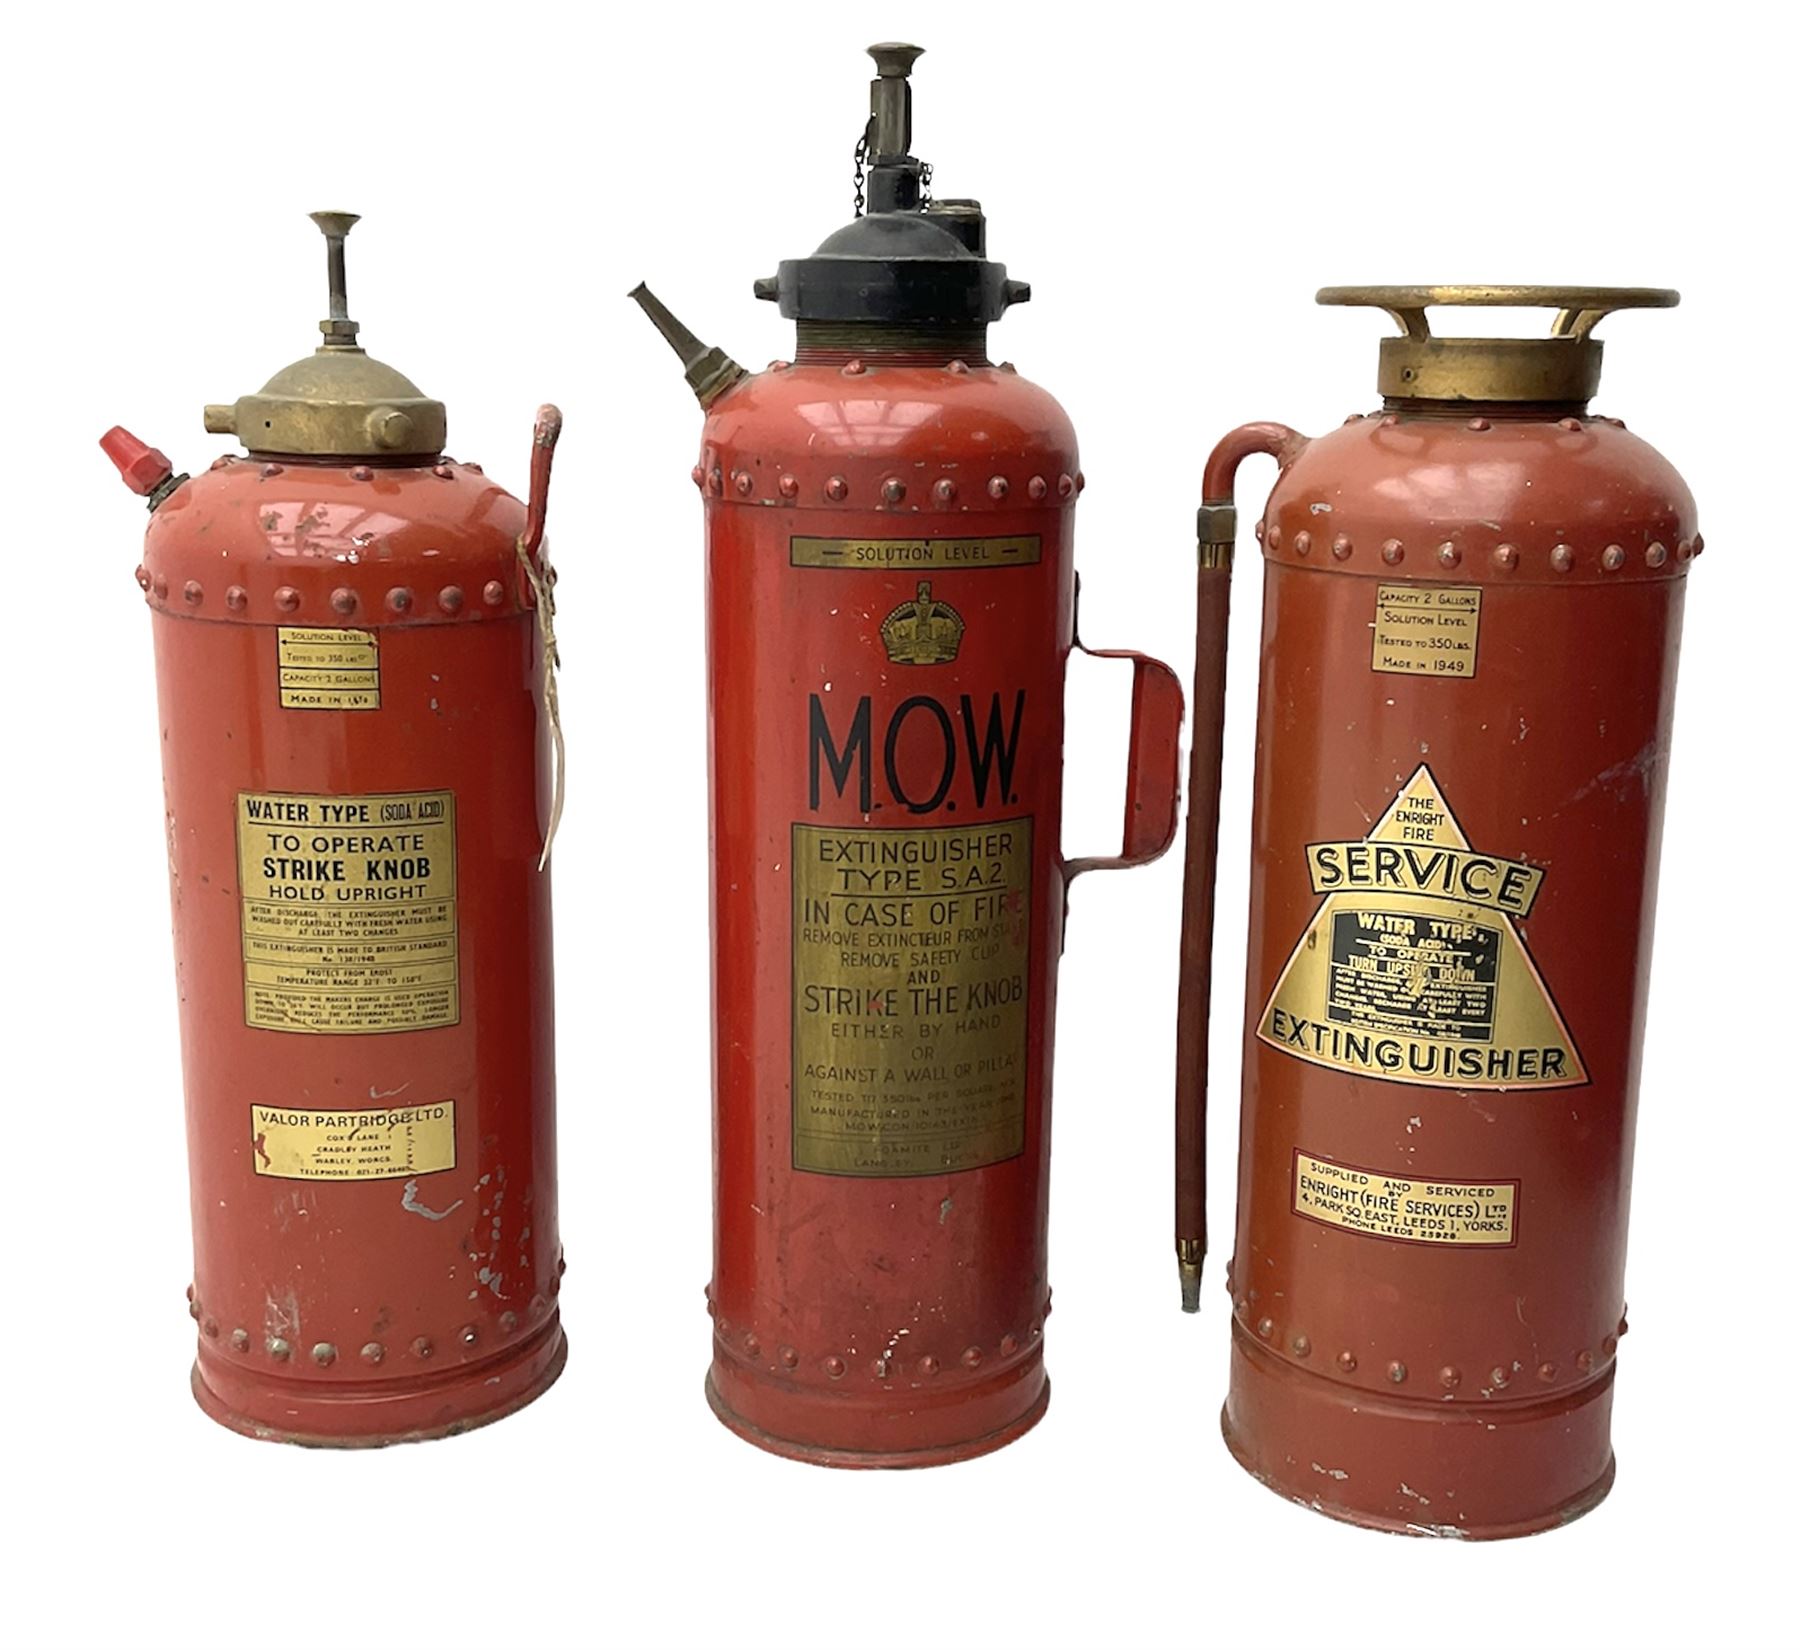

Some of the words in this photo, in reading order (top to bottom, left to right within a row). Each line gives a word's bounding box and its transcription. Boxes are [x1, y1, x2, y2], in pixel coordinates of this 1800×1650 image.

[856, 547, 933, 561] SOLUTION
[945, 546, 990, 560] LEVEL
[1379, 590, 1420, 603] CAPACITY
[1424, 593, 1432, 604] 2
[1438, 594, 1477, 606] GALLONS
[1384, 610, 1434, 625] SOLUTION
[1437, 614, 1468, 627] LEVEL
[291, 632, 334, 641] SOLUTION
[338, 634, 362, 642] LEVEL
[1415, 640, 1427, 648] TO
[1383, 656, 1411, 669] MADE
[1434, 660, 1465, 672] 1949
[325, 675, 332, 683] 2
[291, 695, 321, 704] MADE
[329, 696, 341, 704] IN
[809, 688, 1026, 815] M.O.W.
[247, 799, 309, 822] WATER
[319, 805, 370, 822] TYPE
[380, 803, 412, 822] (SODA
[1408, 797, 1434, 810] THE
[1395, 810, 1445, 826] ENRIGHT
[1403, 826, 1434, 841] FIRE
[267, 833, 300, 851] TO
[311, 834, 425, 853] OPERATE
[819, 833, 1013, 864] EXTINGUISHER
[263, 857, 346, 881] STRIKE
[366, 856, 431, 881] KNOB
[837, 867, 921, 891] TYPE
[1316, 847, 1533, 909] SERVICE
[269, 885, 325, 901] HOLD
[337, 884, 427, 901] UPRIGHT
[328, 911, 342, 919] THE
[804, 897, 830, 925] IN
[845, 902, 914, 927] CASE
[930, 900, 960, 925] OF
[298, 928, 308, 936] AT
[1357, 912, 1416, 936] WATER
[409, 940, 448, 951] STANDARD
[803, 928, 859, 947] REMOVE
[868, 931, 951, 948] EXTINCTEUR
[957, 927, 990, 944] FROM
[840, 952, 899, 968] REMOVE
[910, 950, 962, 967] SAFETY
[1368, 945, 1387, 957] TO
[1348, 954, 1378, 972] TURN
[1386, 960, 1432, 979] UPSI
[906, 969, 941, 985] AND
[804, 984, 898, 1017] STRIKE
[907, 986, 959, 1016] THE
[966, 975, 1023, 1011] KNOB
[831, 1022, 904, 1039] EITHER
[920, 1024, 943, 1038] BY
[955, 1015, 1000, 1034] HAND
[1272, 1007, 1567, 1080] EXTINGUISHER
[911, 1047, 935, 1061] OR
[804, 1064, 878, 1083] AGAINST
[883, 1068, 896, 1083] A
[904, 1066, 948, 1083] WALL
[954, 1062, 972, 1079] OR
[977, 1055, 1017, 1074] PILLA
[259, 1111, 310, 1126] VALOR
[811, 1105, 911, 1119] MANUFACTURED
[1311, 1162, 1369, 1185] SUPPLIED
[1383, 1181, 1411, 1193] AND
[1426, 1186, 1495, 1198] SERVICED
[1300, 1175, 1358, 1204] ENRIGHT
[1360, 1188, 1399, 1213] (FIRE
[1405, 1200, 1480, 1220] SERVICES)
[1314, 1197, 1344, 1214] PARK
[1404, 1216, 1446, 1230] LEEDS
[1463, 1220, 1508, 1232] YORKS.
[1341, 1215, 1377, 1230] PHONE
[1381, 1225, 1414, 1236] LEEDS
